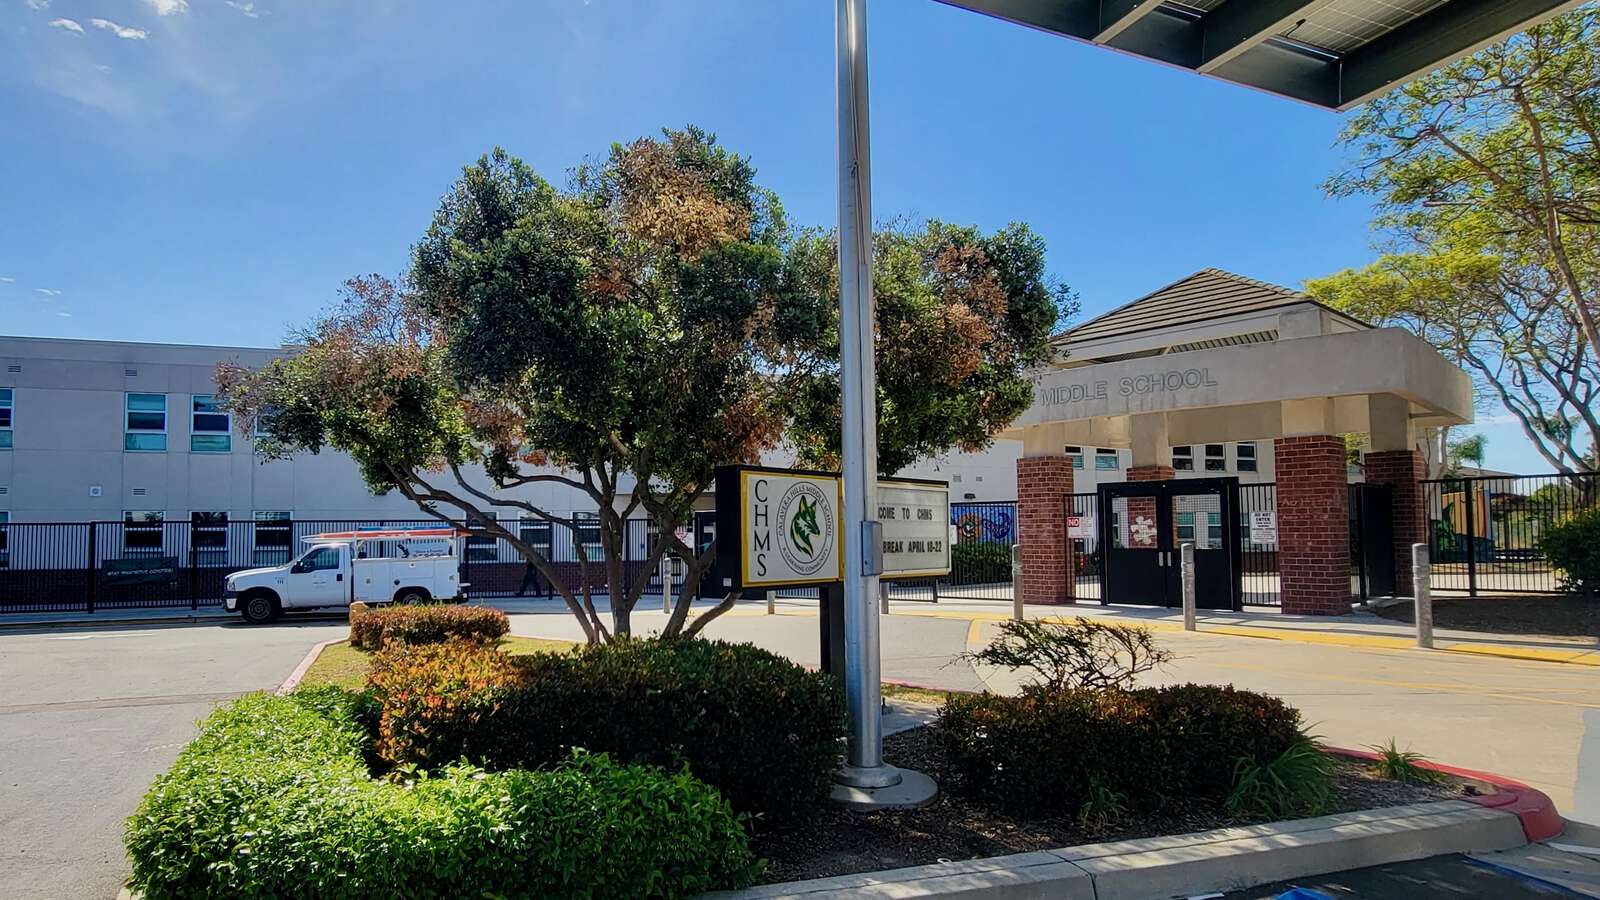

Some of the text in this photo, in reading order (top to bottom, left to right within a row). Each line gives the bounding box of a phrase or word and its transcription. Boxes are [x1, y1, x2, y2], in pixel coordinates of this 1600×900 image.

[1040, 368, 1217, 406] MIDDLE SCHOOL
[790, 485, 805, 499] HILLS
[806, 486, 824, 504] MIDDLE
[823, 504, 832, 536] SCHOOL
[902, 507, 910, 520] TO
[1068, 518, 1079, 526] NO
[883, 541, 903, 553] BREAK
[908, 541, 925, 553] APRIL
